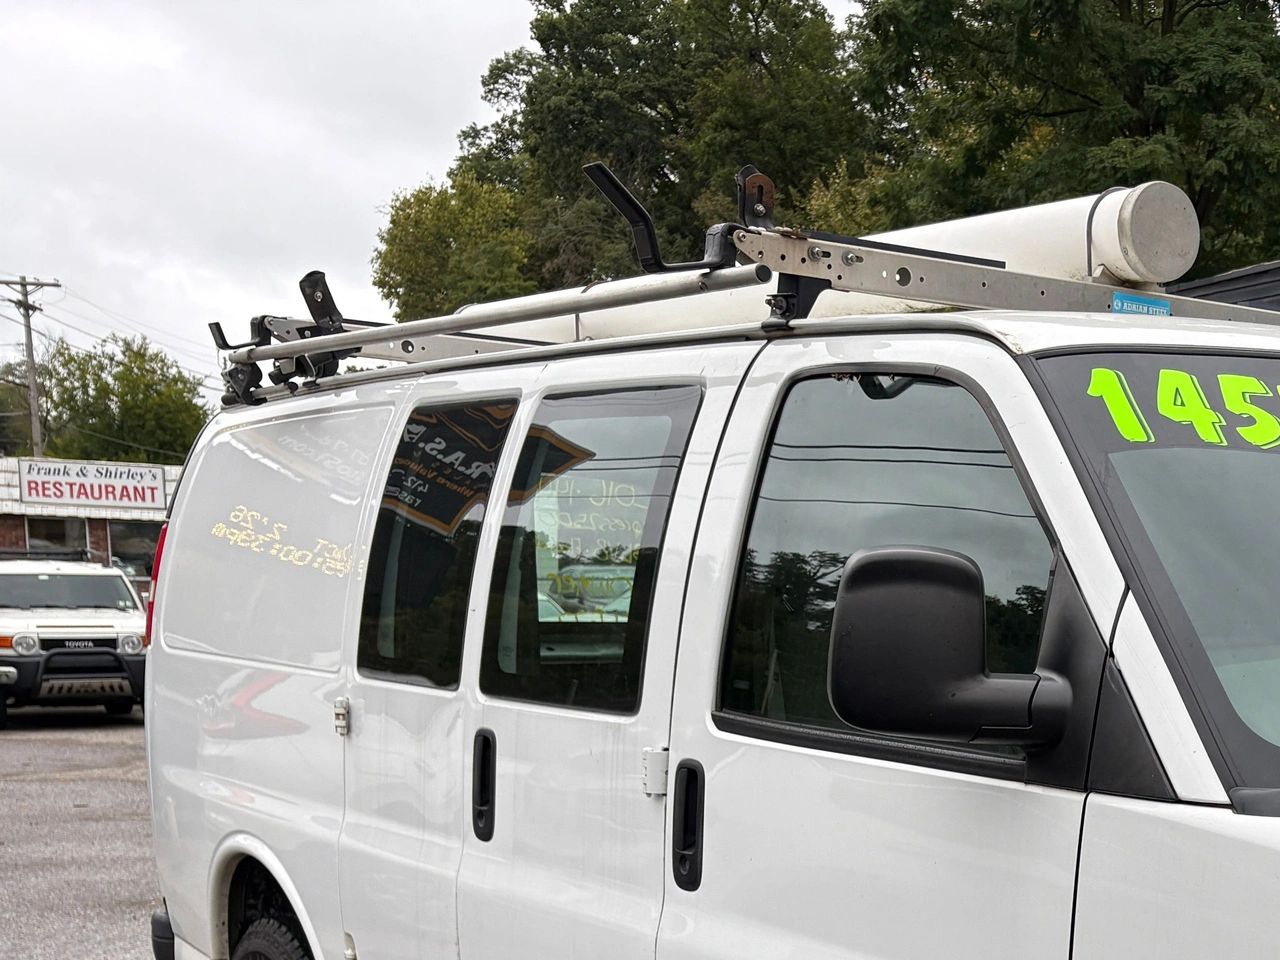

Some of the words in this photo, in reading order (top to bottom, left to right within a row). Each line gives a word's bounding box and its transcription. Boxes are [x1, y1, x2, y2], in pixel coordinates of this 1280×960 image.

[1123, 302, 1148, 314] ADRIAN
[26, 463, 71, 476] Frank
[76, 467, 88, 478] &
[94, 467, 158, 483] Shirley's
[27, 480, 158, 503] RESTAURANT
[64, 640, 94, 648] TOYOTA
